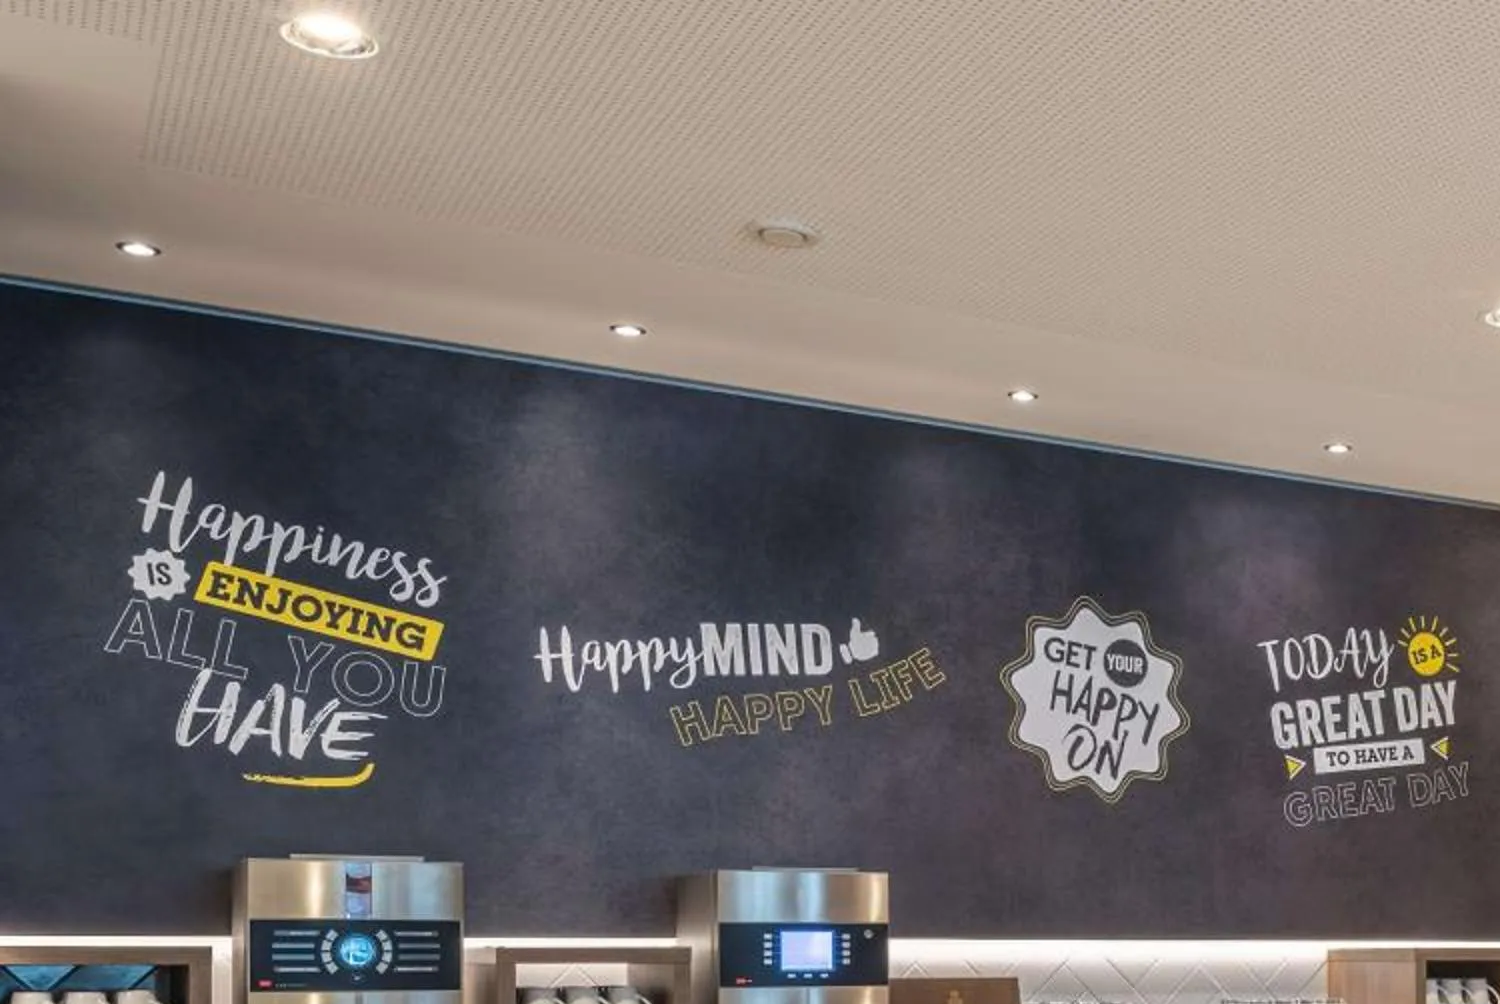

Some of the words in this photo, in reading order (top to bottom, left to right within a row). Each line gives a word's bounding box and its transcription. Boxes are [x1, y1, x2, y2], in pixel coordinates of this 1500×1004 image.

[137, 471, 447, 607] Happiness
[147, 562, 172, 585] IS
[206, 570, 427, 651] ENJOYING
[103, 599, 248, 680] ALL
[288, 635, 446, 717] YOU
[1044, 637, 1097, 670] GET
[1106, 653, 1143, 675] YOUR
[1256, 627, 1395, 693] TODAY
[1412, 649, 1428, 666] IS
[1430, 644, 1442, 660] A
[175, 668, 388, 760] HAVE
[669, 686, 834, 747] HAPPY
[848, 647, 946, 717] LIFE
[1050, 670, 1159, 745] HAPPY
[1270, 689, 1386, 750] GREAT
[1393, 680, 1457, 733] DAY
[1061, 724, 1128, 780] ON
[1325, 751, 1349, 767] TO
[1355, 746, 1399, 765] HAVE
[1402, 745, 1415, 761] A
[1283, 777, 1398, 827] GREAT
[1407, 761, 1470, 808] DAY
